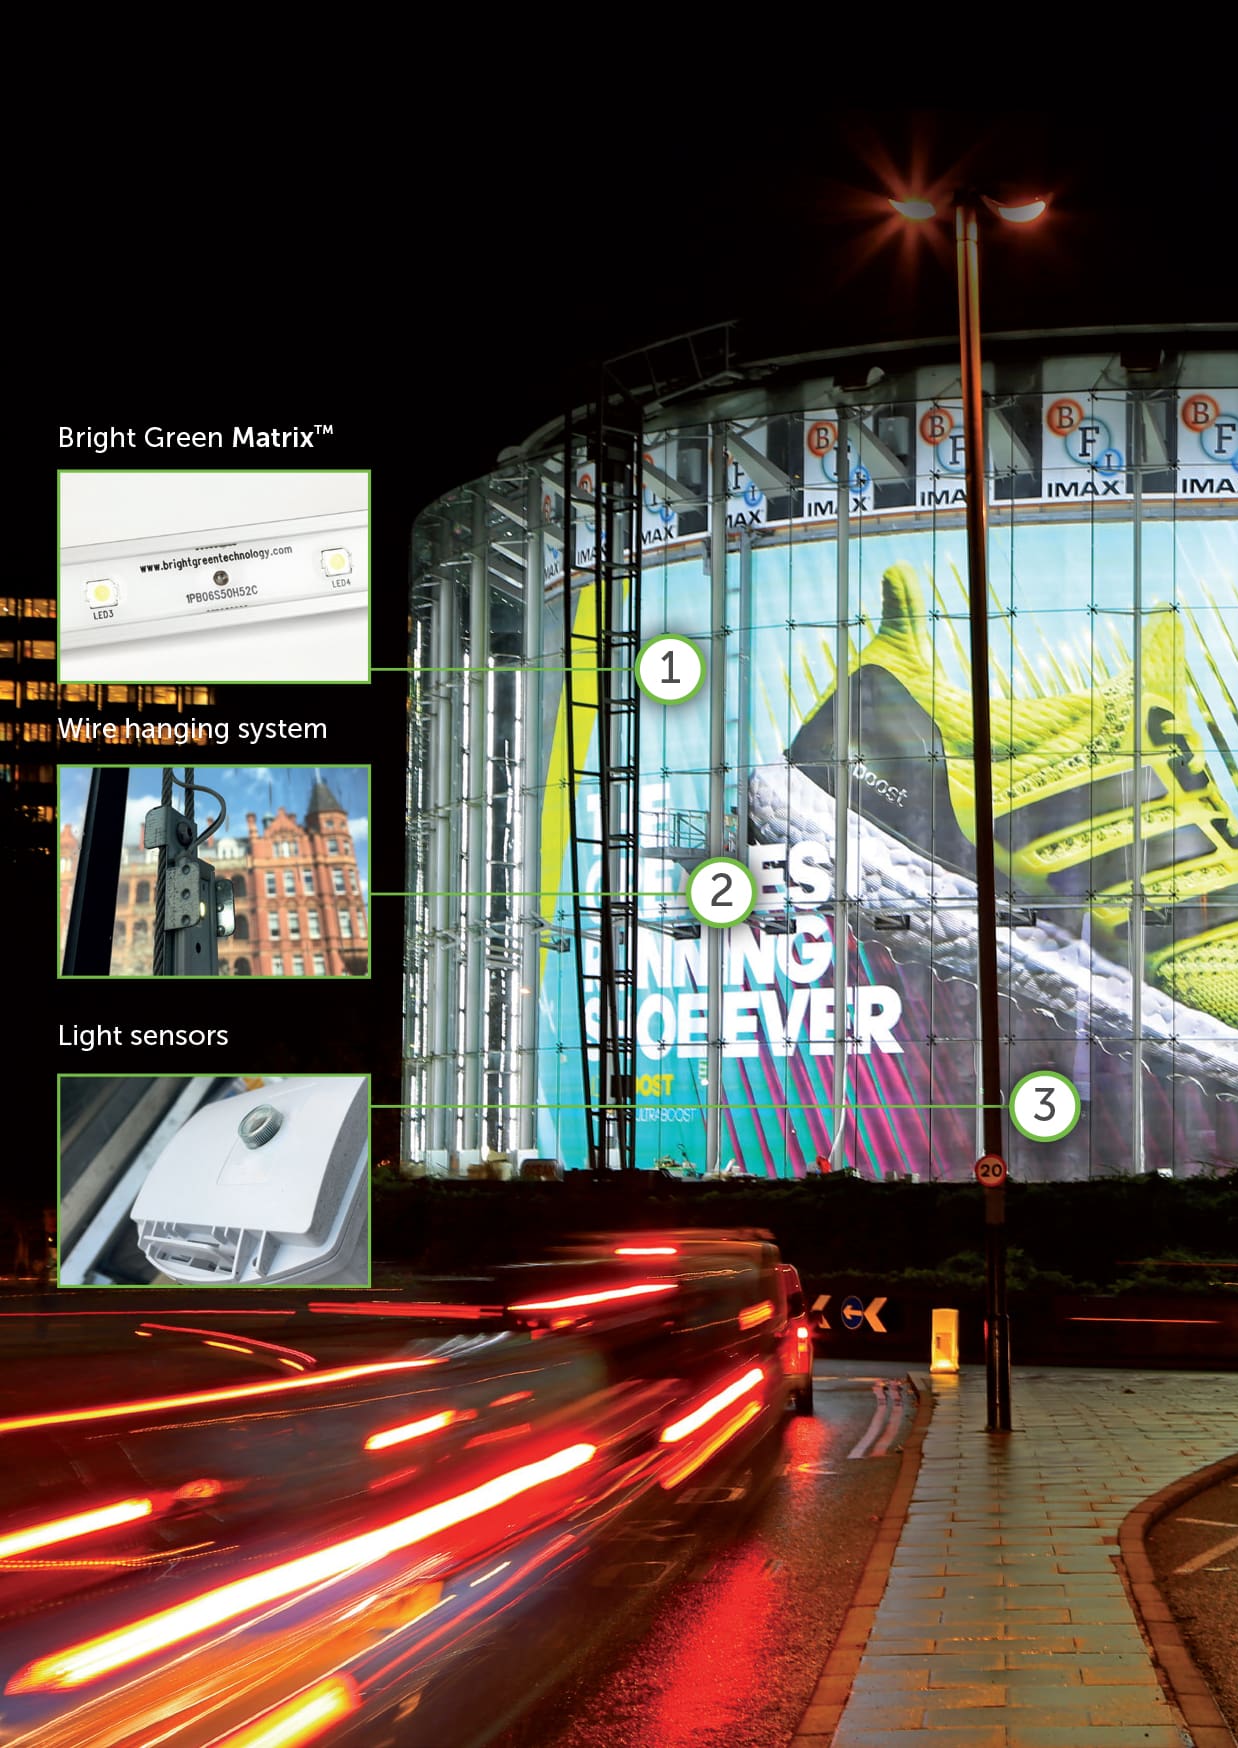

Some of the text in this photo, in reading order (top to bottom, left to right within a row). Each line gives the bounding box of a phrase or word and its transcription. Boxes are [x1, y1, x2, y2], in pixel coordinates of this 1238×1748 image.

[920, 489, 967, 506] IMA
[1047, 480, 1121, 498] IMAX
[140, 545, 293, 573] www.brightgreentechnology.com
[331, 578, 351, 589] LED4
[93, 610, 115, 620] LED3
[853, 761, 908, 808] boost
[721, 984, 905, 1059] EVER
[981, 1164, 1002, 1178] 20
